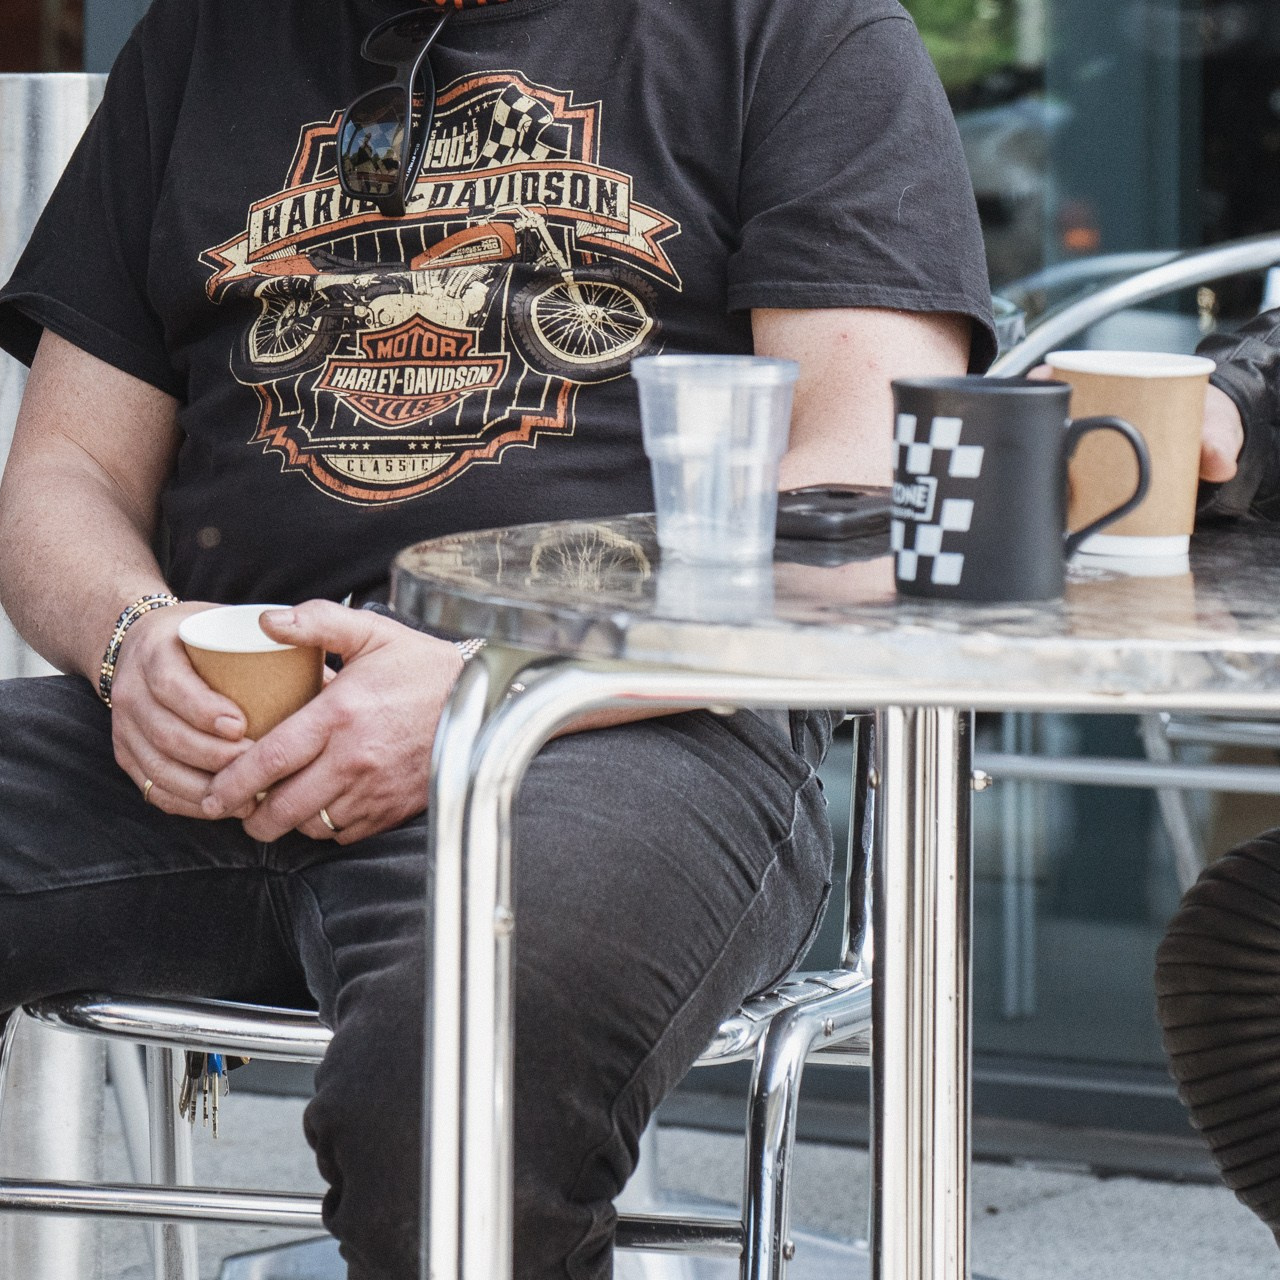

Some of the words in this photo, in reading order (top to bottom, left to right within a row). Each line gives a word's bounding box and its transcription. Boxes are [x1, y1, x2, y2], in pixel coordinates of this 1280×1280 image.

[423, 129, 479, 169] 1903
[376, 326, 458, 359] MOTOR
[330, 366, 494, 395] HARLEY-DAVIDSON
[360, 395, 445, 420] CYCLES
[347, 459, 429, 473] CLASSIC
